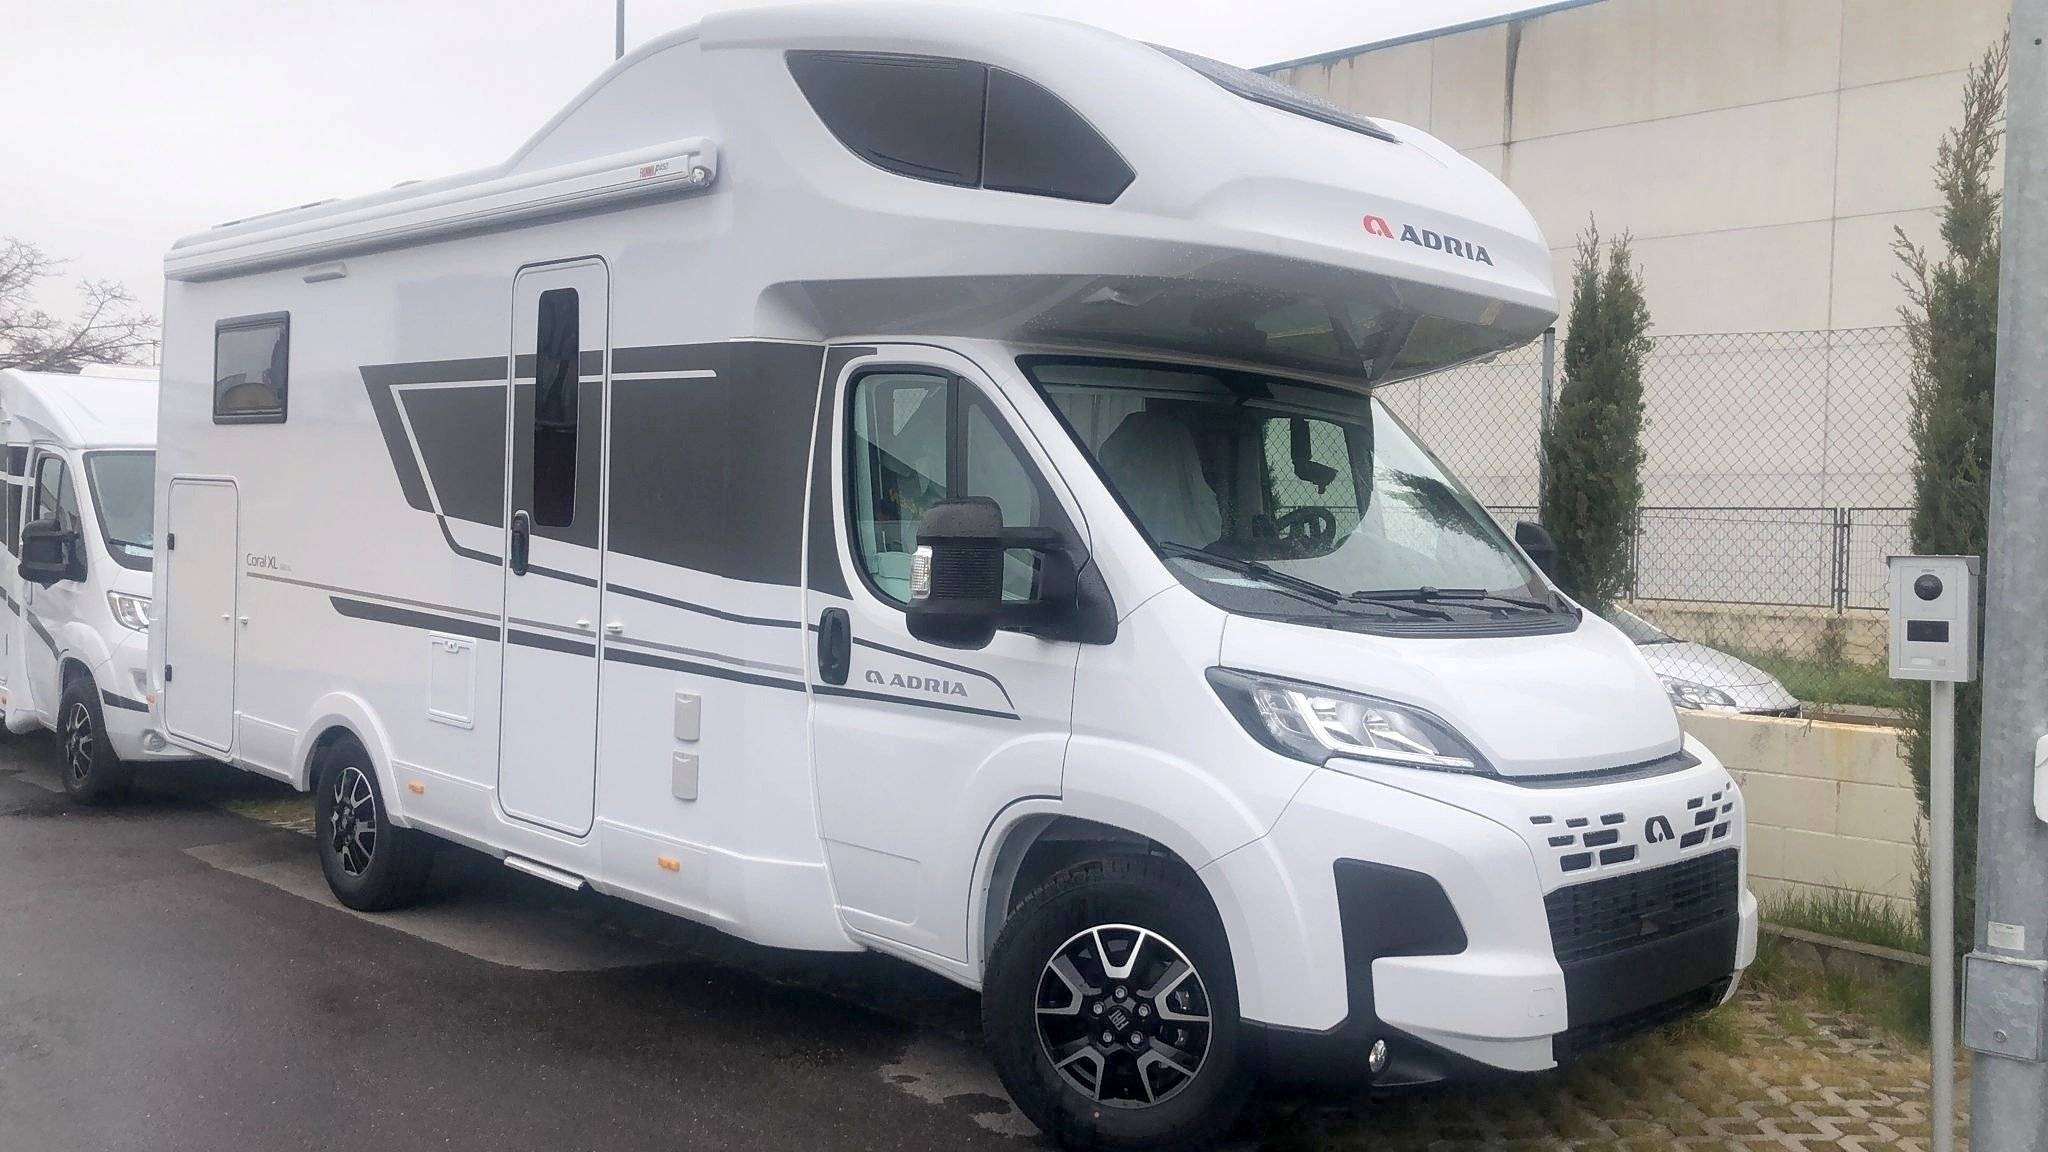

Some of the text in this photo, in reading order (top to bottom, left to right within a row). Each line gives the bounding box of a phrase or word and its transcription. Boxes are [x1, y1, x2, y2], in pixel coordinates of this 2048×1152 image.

[1400, 224, 1495, 267] ADRIA
[246, 552, 267, 568] Coral
[267, 556, 279, 570] XL
[890, 673, 968, 697] ADRIA
